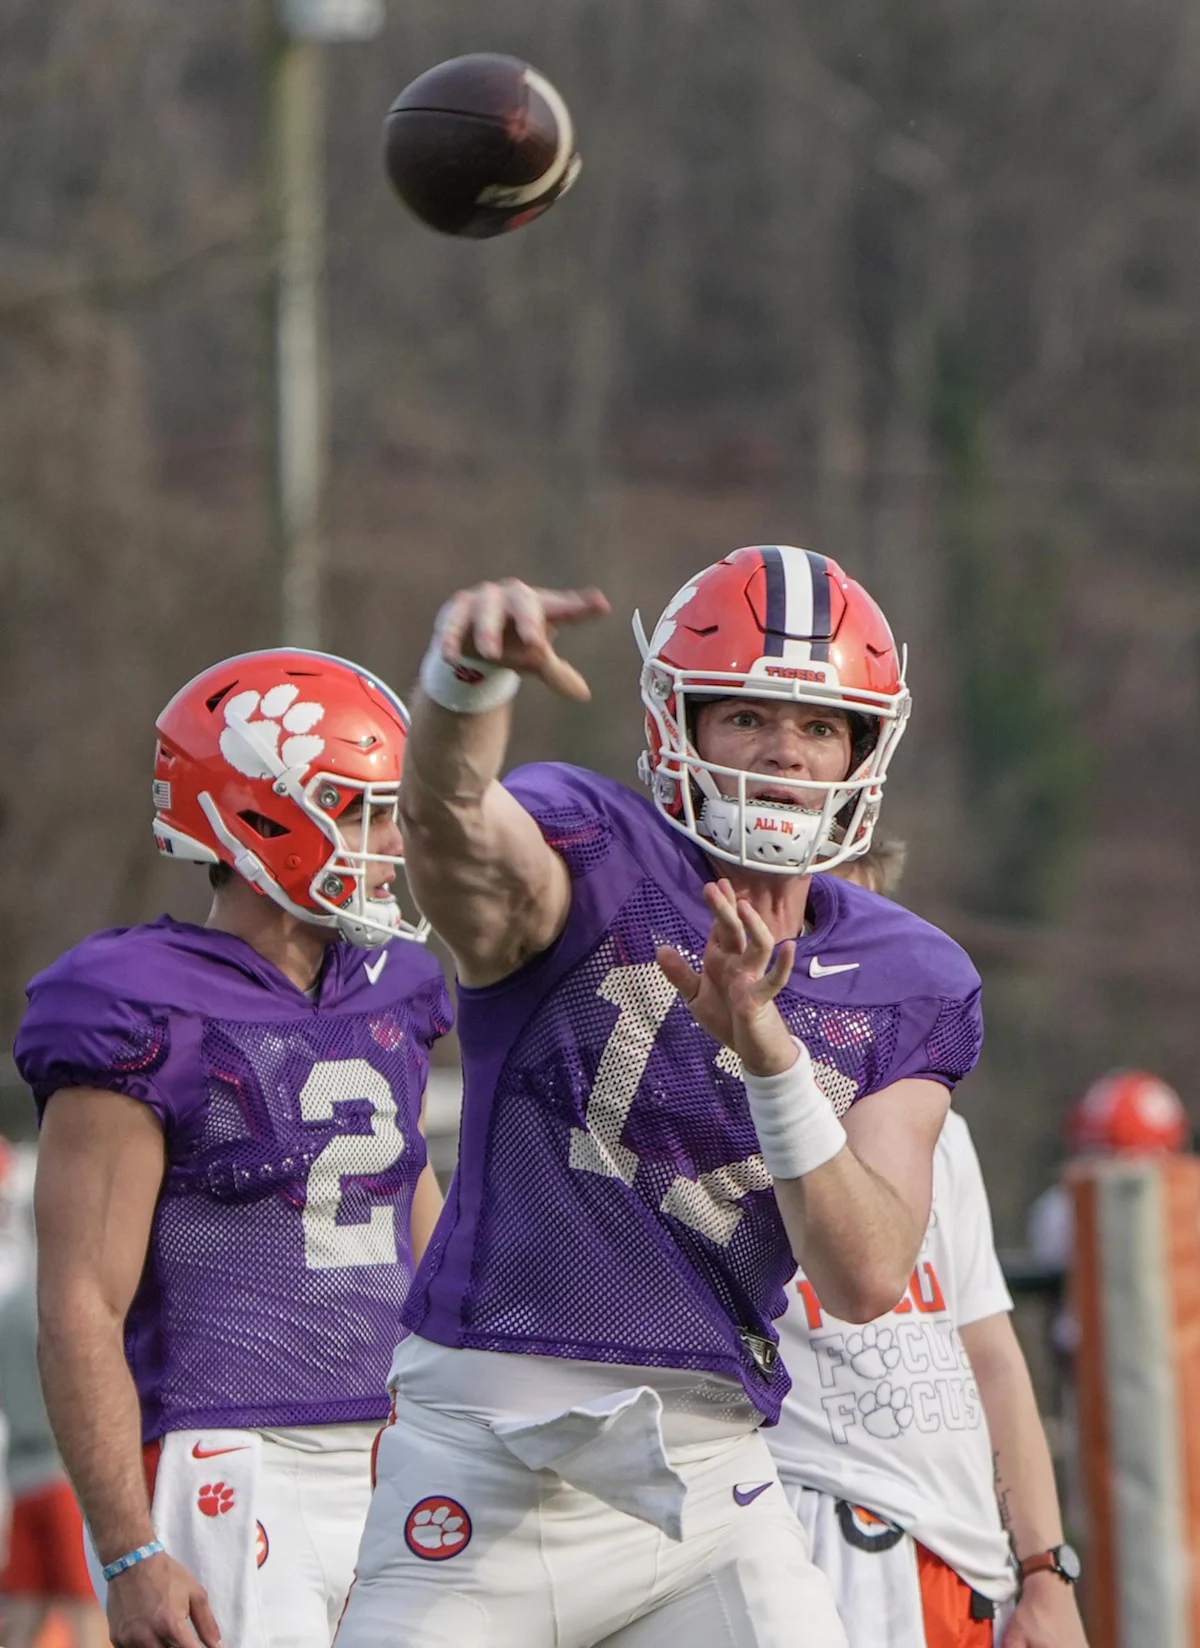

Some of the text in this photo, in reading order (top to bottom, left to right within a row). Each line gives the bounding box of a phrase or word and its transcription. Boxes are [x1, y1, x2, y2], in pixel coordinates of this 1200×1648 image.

[764, 666, 826, 683] TIGERS
[753, 817, 794, 835] ALL IN
[299, 1057, 405, 1271] 2
